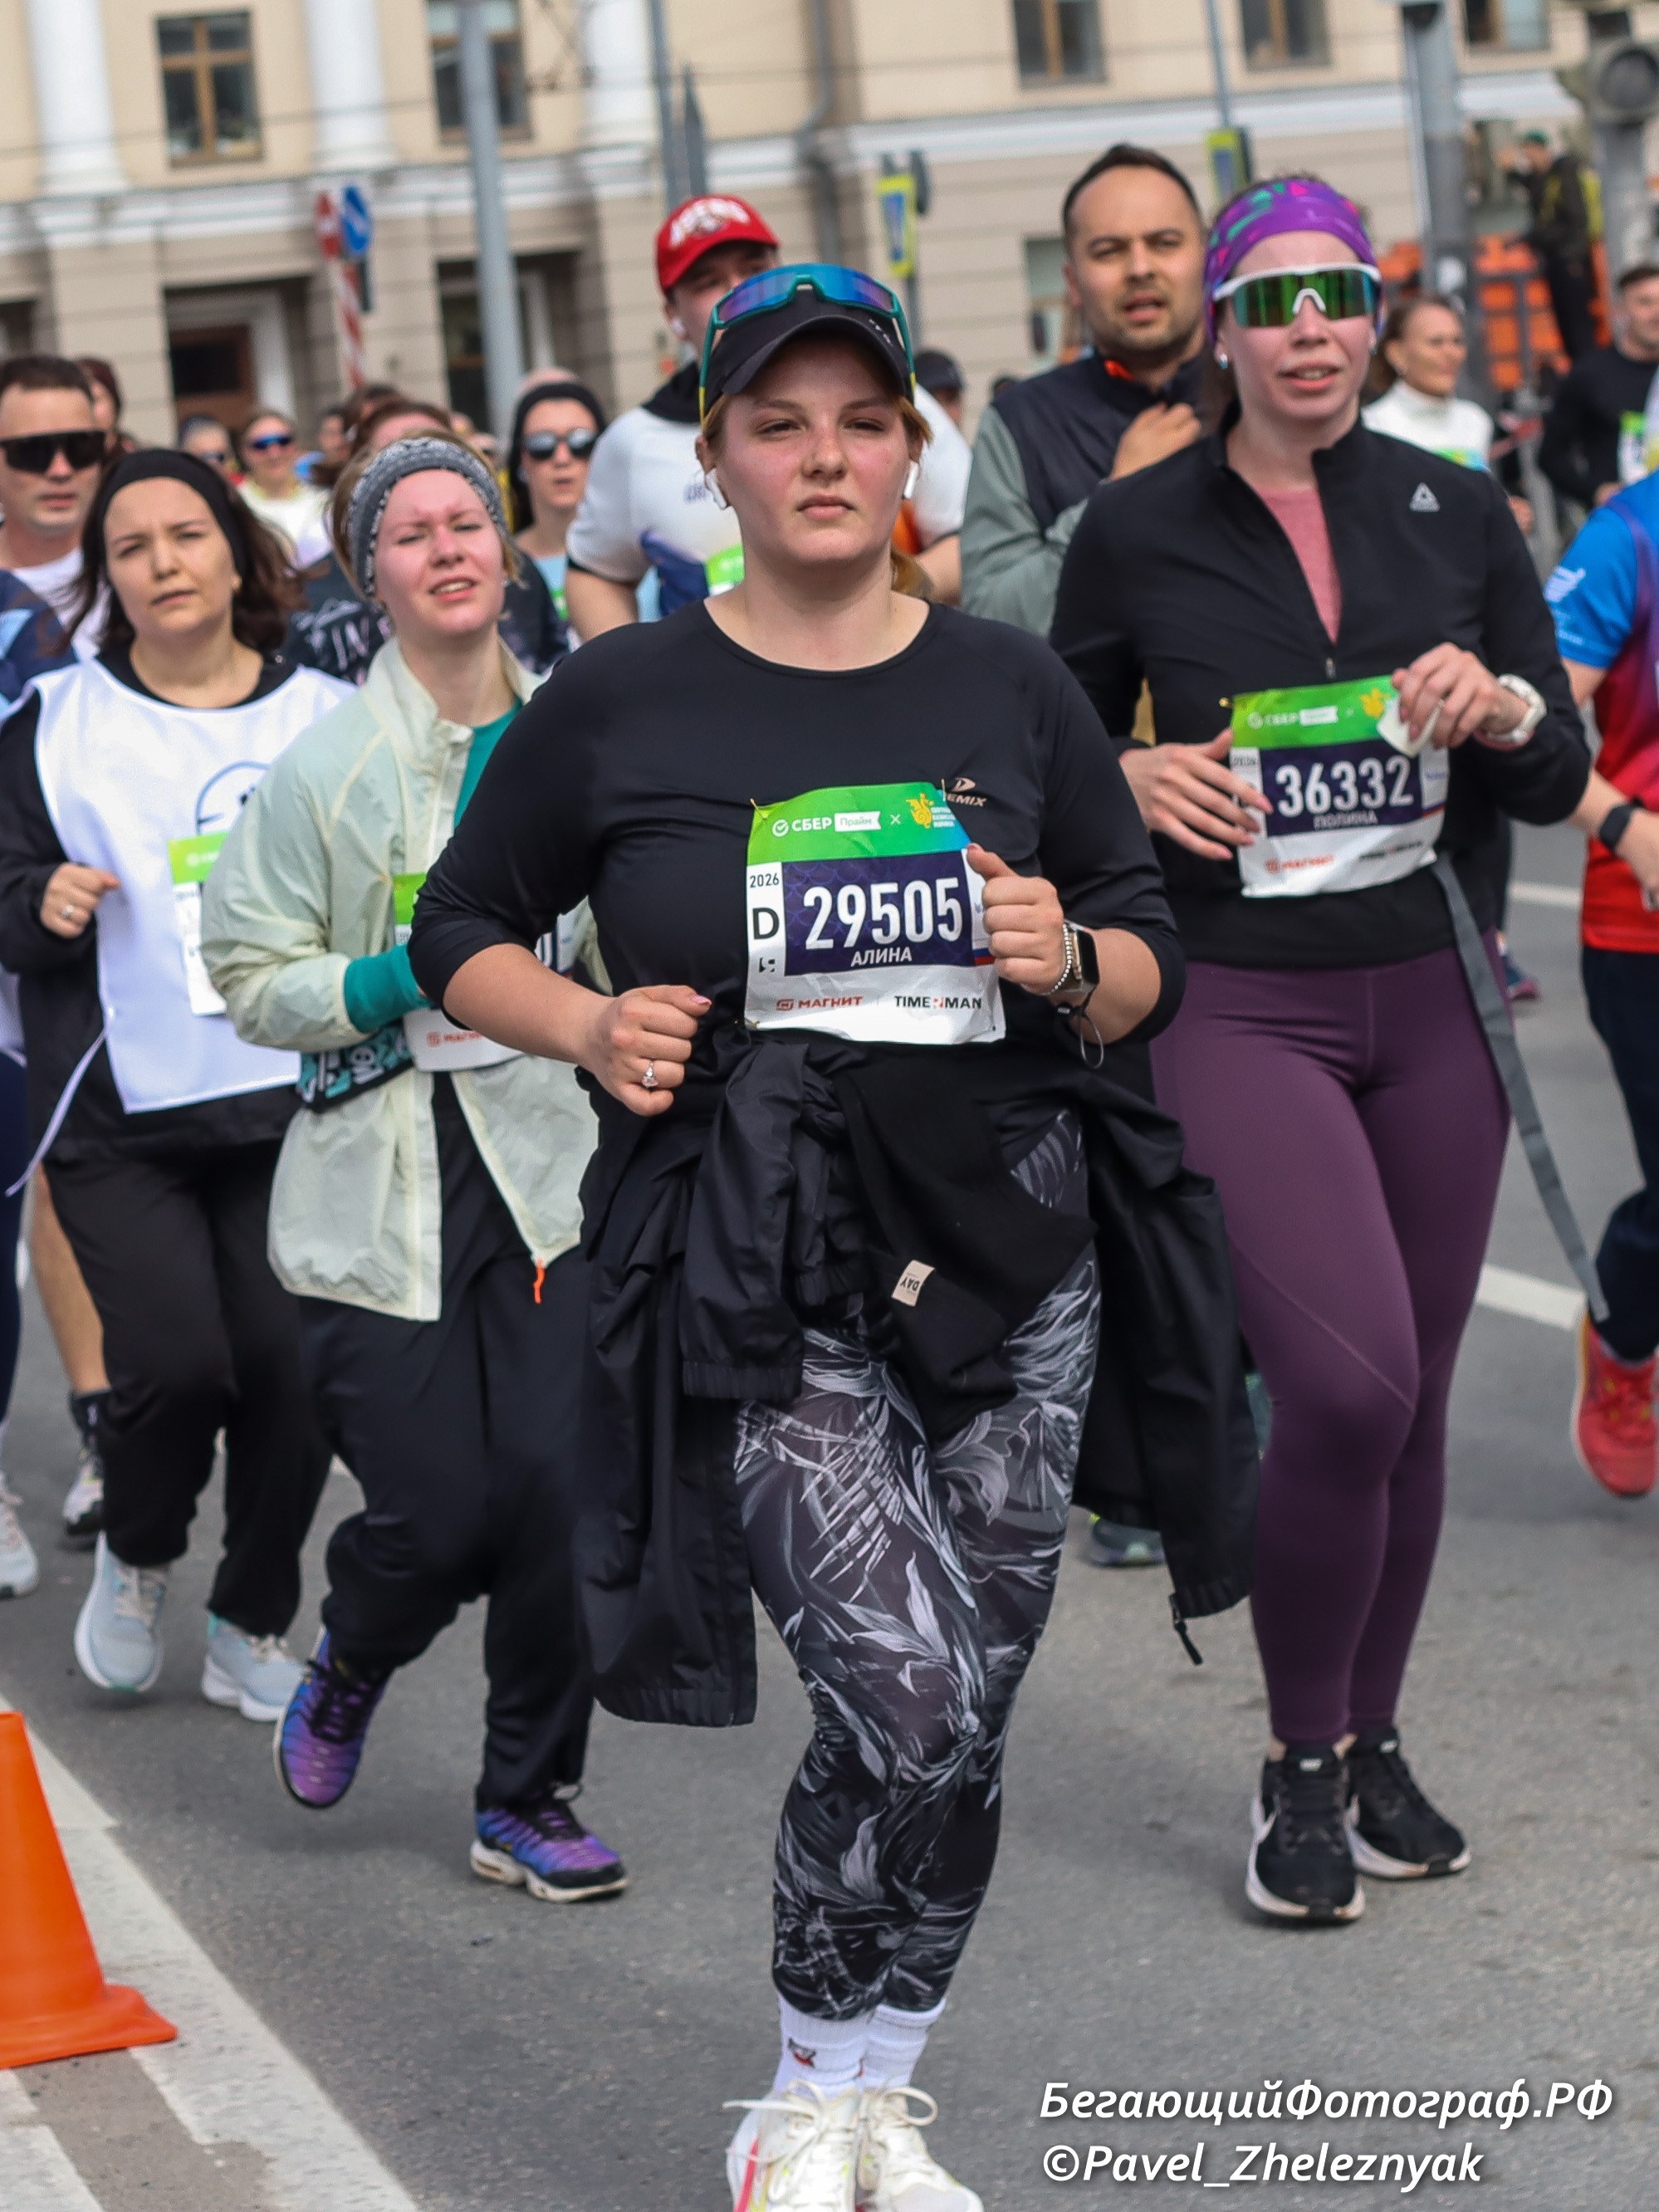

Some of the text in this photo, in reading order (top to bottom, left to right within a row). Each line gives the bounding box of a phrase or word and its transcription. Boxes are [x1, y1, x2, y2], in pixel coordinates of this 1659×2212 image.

[1275, 756, 1414, 817] 36332
[791, 816, 833, 831] СБЕР
[750, 874, 780, 888] 2026
[803, 877, 963, 950] 29505
[752, 908, 780, 940] D
[849, 947, 913, 967] АЛИНА
[798, 996, 864, 1010] МАГНИТ
[899, 1276, 920, 1291] DAY
